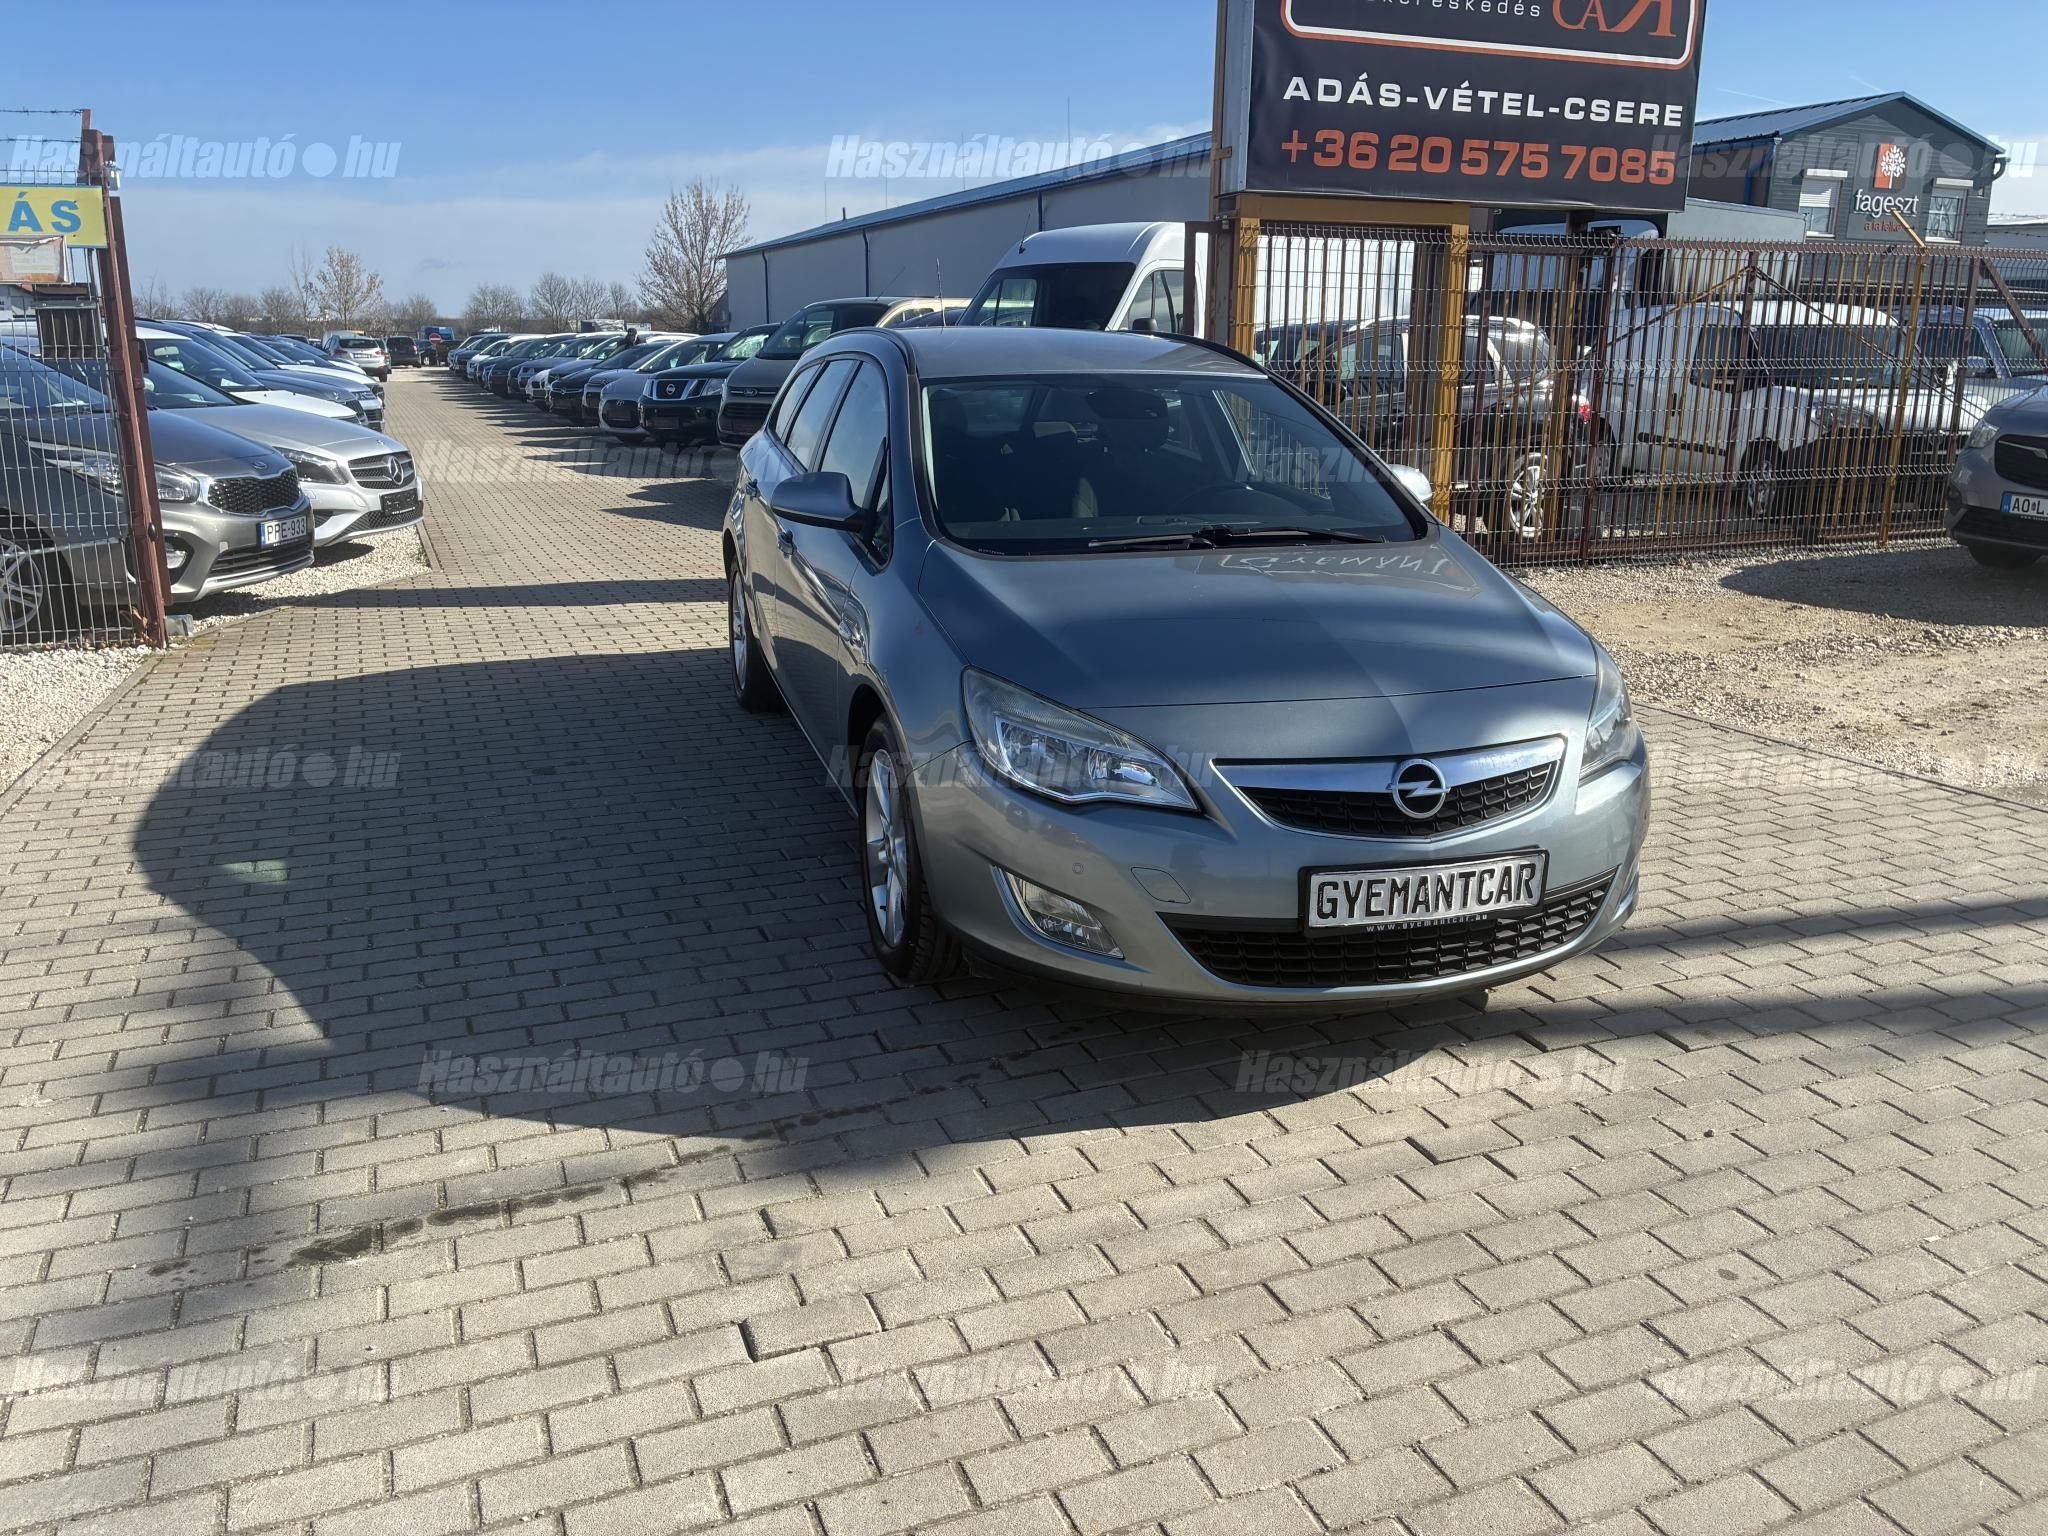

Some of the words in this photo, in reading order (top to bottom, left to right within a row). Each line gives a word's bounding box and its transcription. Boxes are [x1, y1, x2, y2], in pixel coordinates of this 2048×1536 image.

[1283, 72, 1684, 127] ADÁS-VÉTEL-CSERE
[1281, 130, 1378, 170] +36
[1388, 135, 1452, 173] 20
[1460, 140, 1549, 179] 575
[1561, 145, 1676, 185] 7085
[1855, 188, 1920, 218] fageszt
[266, 517, 306, 542] PPE-933
[1315, 862, 1538, 920] GYEMANTCAR
